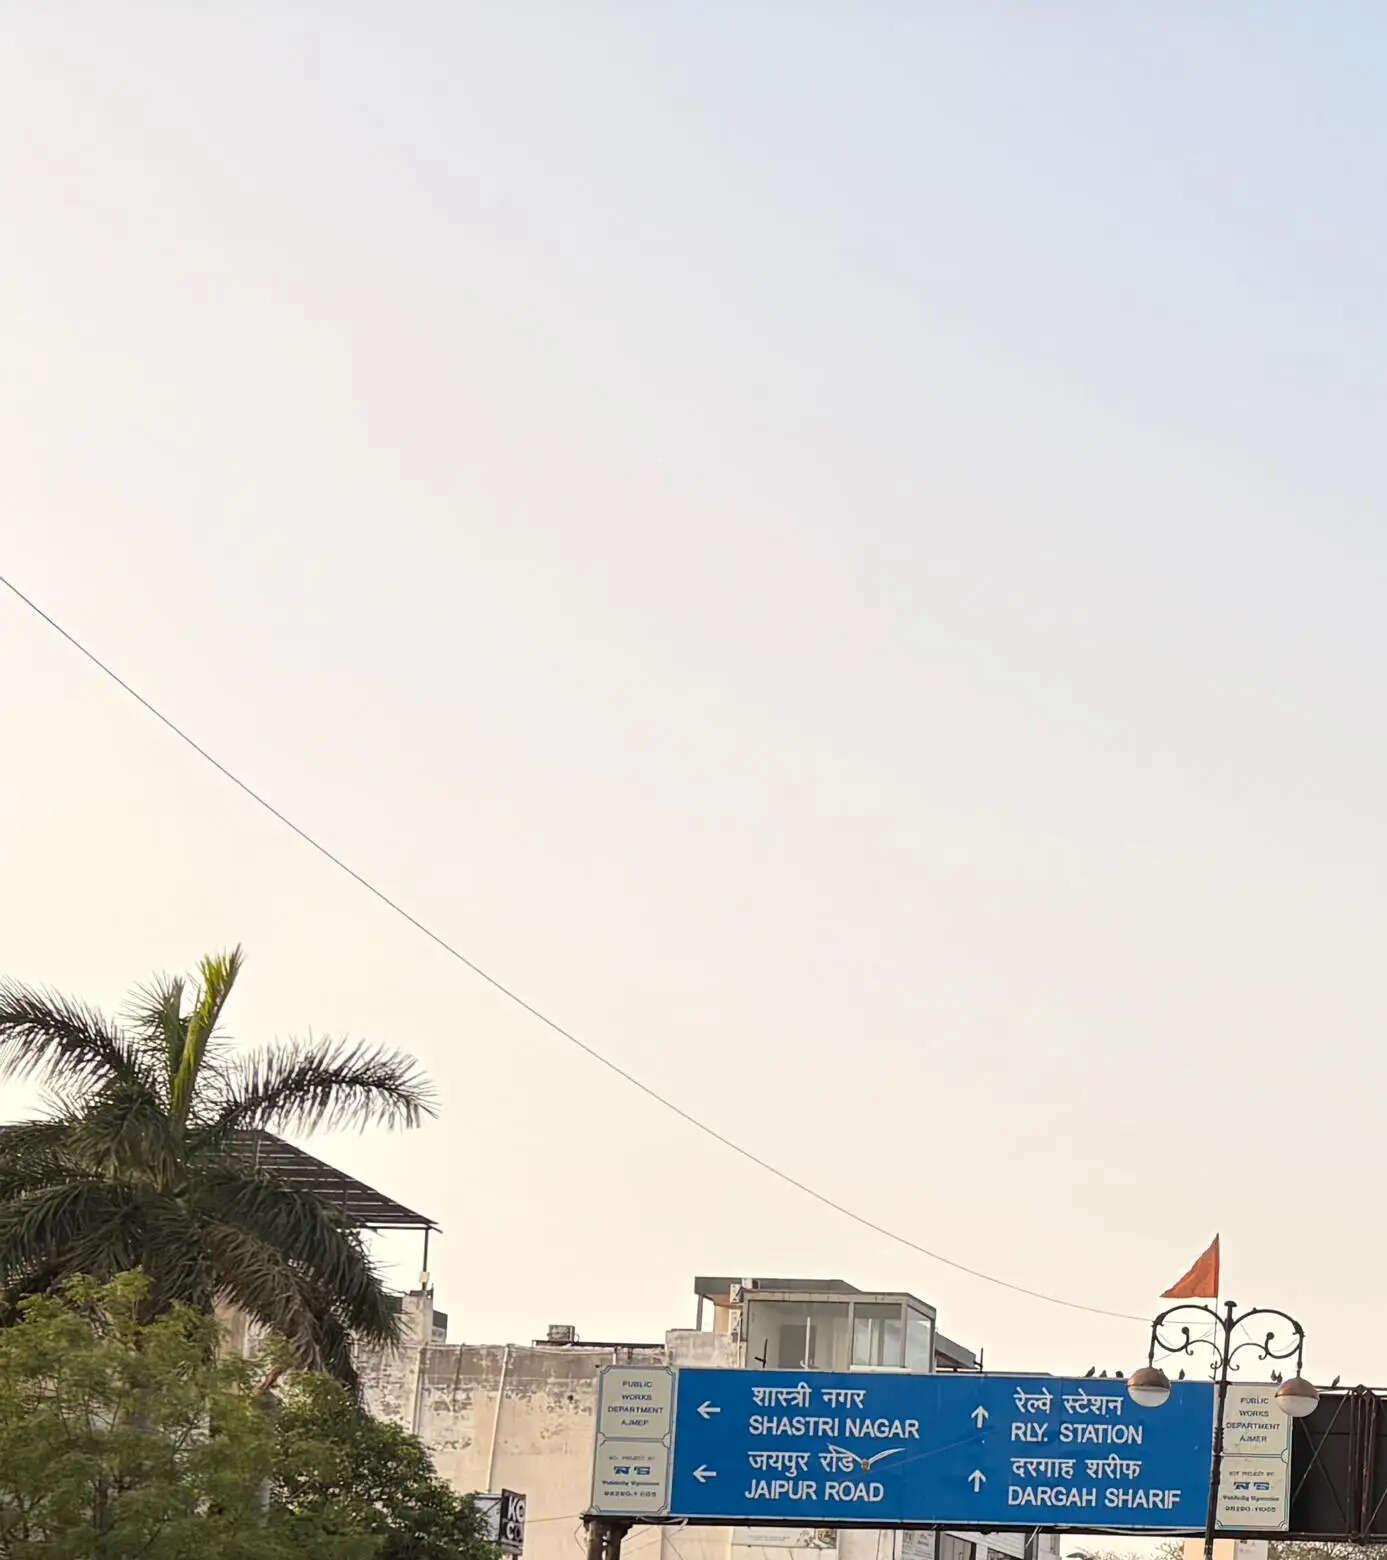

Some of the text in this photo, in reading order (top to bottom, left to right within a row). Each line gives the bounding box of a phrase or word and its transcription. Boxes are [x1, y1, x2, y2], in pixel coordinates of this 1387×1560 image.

[752, 1382, 866, 1409] शास्त्री नगर
[1062, 1388, 1124, 1416] स्टेशन
[1241, 1397, 1269, 1405] PUBLIC
[608, 1405, 664, 1414] DEPARTMENT
[749, 1416, 920, 1439] SHASTRI NAGAR
[1011, 1423, 1143, 1445] RLY. STATION
[1226, 1423, 1280, 1431] DEPARTMENT
[1239, 1435, 1268, 1443] AJMER
[748, 1451, 810, 1477] जयपुर
[1011, 1454, 1142, 1480] दरगाह शरीफ
[745, 1480, 884, 1501] JAIPUR ROAD
[1008, 1486, 1181, 1510] DARGAH SHARIF
